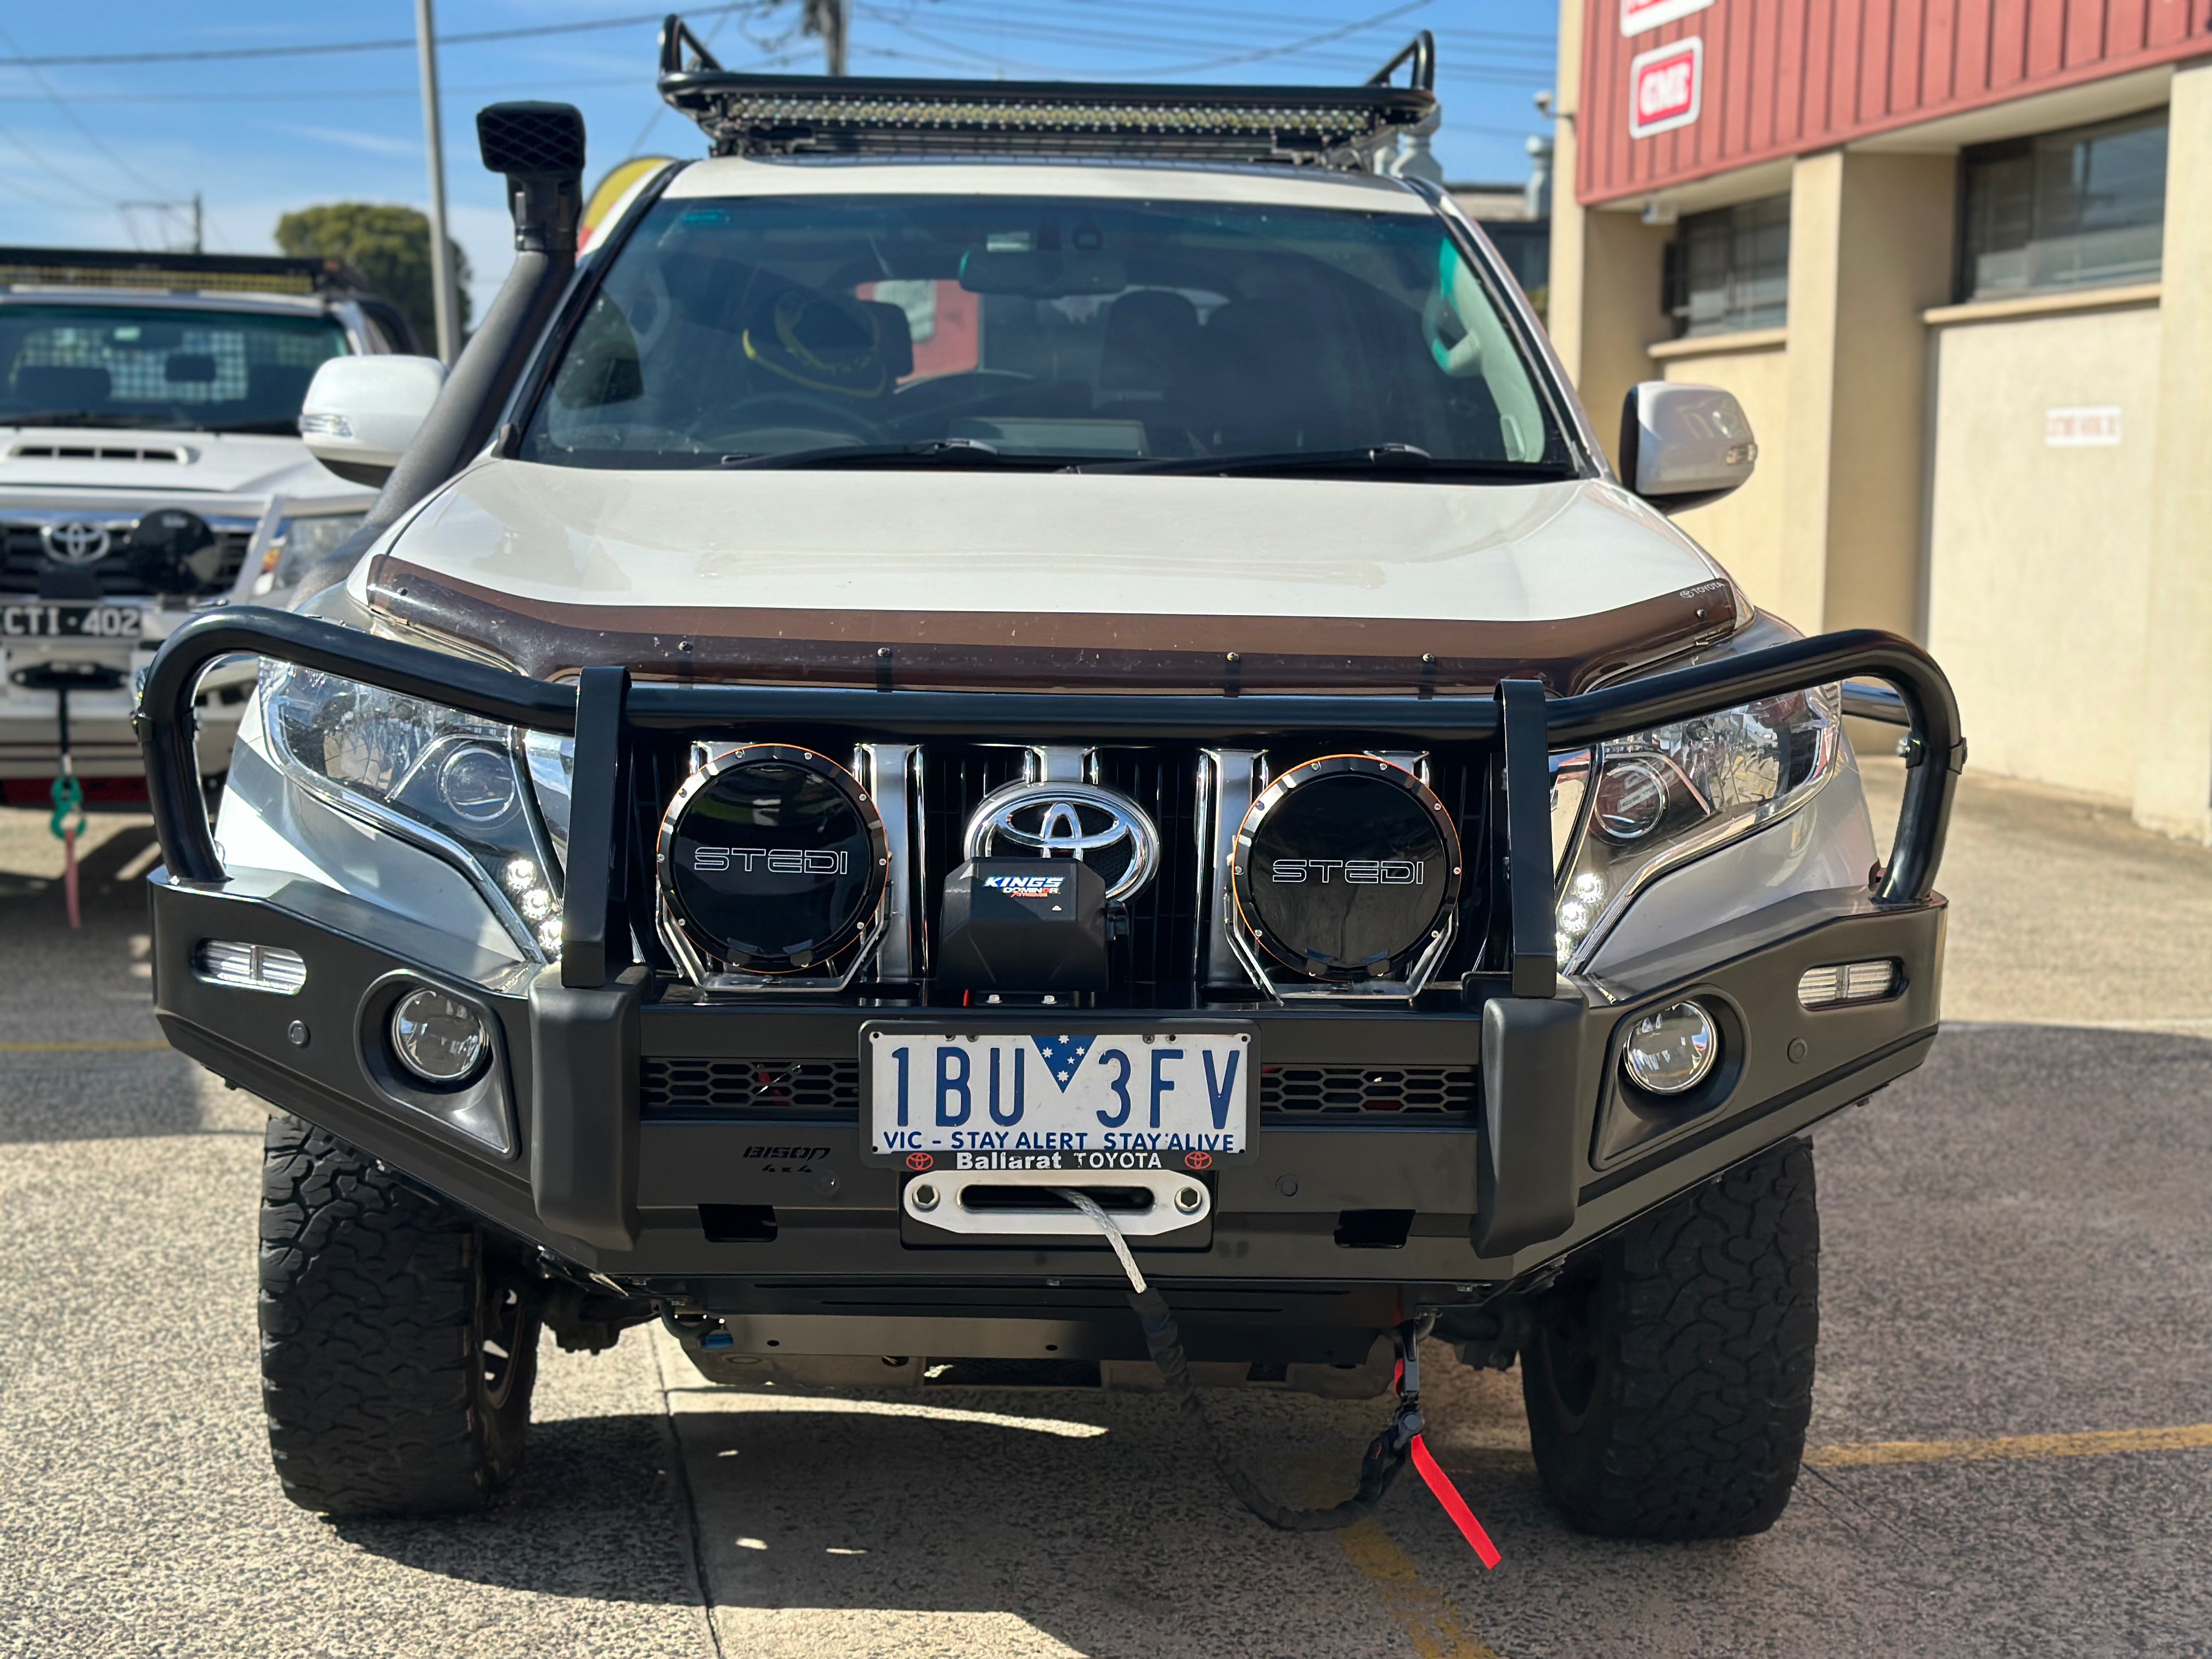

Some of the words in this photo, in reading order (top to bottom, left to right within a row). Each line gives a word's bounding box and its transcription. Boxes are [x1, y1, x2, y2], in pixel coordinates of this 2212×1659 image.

[1691, 582, 1725, 595] TOYOTA
[695, 847, 848, 874] STEDI
[1272, 859, 1424, 884] STEDI
[984, 877, 1065, 887] KINGS
[883, 1131, 922, 1149] VIC
[951, 1131, 1009, 1149] STAY
[1015, 1132, 1088, 1150] ALERT
[1104, 1133, 1161, 1150] STAY
[1167, 1133, 1234, 1152] ALIVE
[956, 1152, 1062, 1170] Ballarat
[1073, 1153, 1162, 1169] TOYOTA
